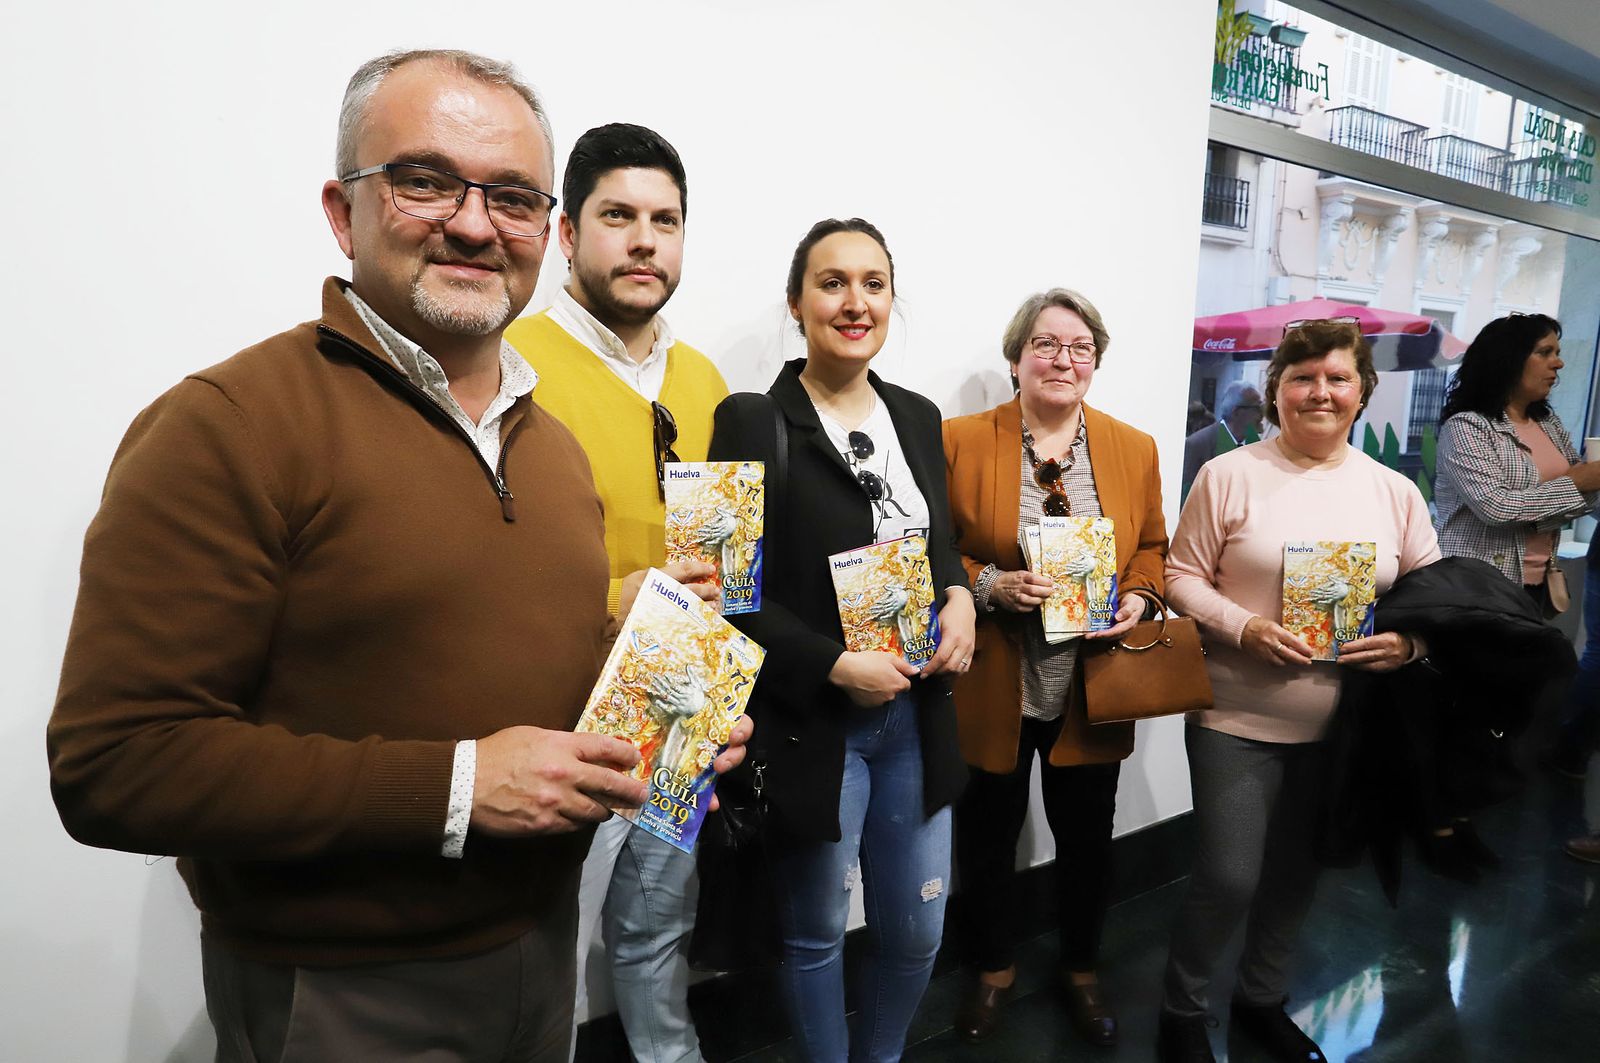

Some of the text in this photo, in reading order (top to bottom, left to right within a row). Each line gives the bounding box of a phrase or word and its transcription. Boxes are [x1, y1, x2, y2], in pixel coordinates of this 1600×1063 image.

[669, 469, 700, 479] Huelva
[1287, 546, 1314, 554] Huelva
[833, 557, 863, 570] Huelva
[650, 579, 689, 611] Huelva
[726, 588, 753, 601] 2019
[1091, 612, 1111, 622] 2019
[909, 648, 935, 662] 2019
[674, 767, 690, 784] LA
[649, 792, 689, 825] 2019
[644, 809, 662, 824] Semana
[662, 818, 676, 831] Santa
